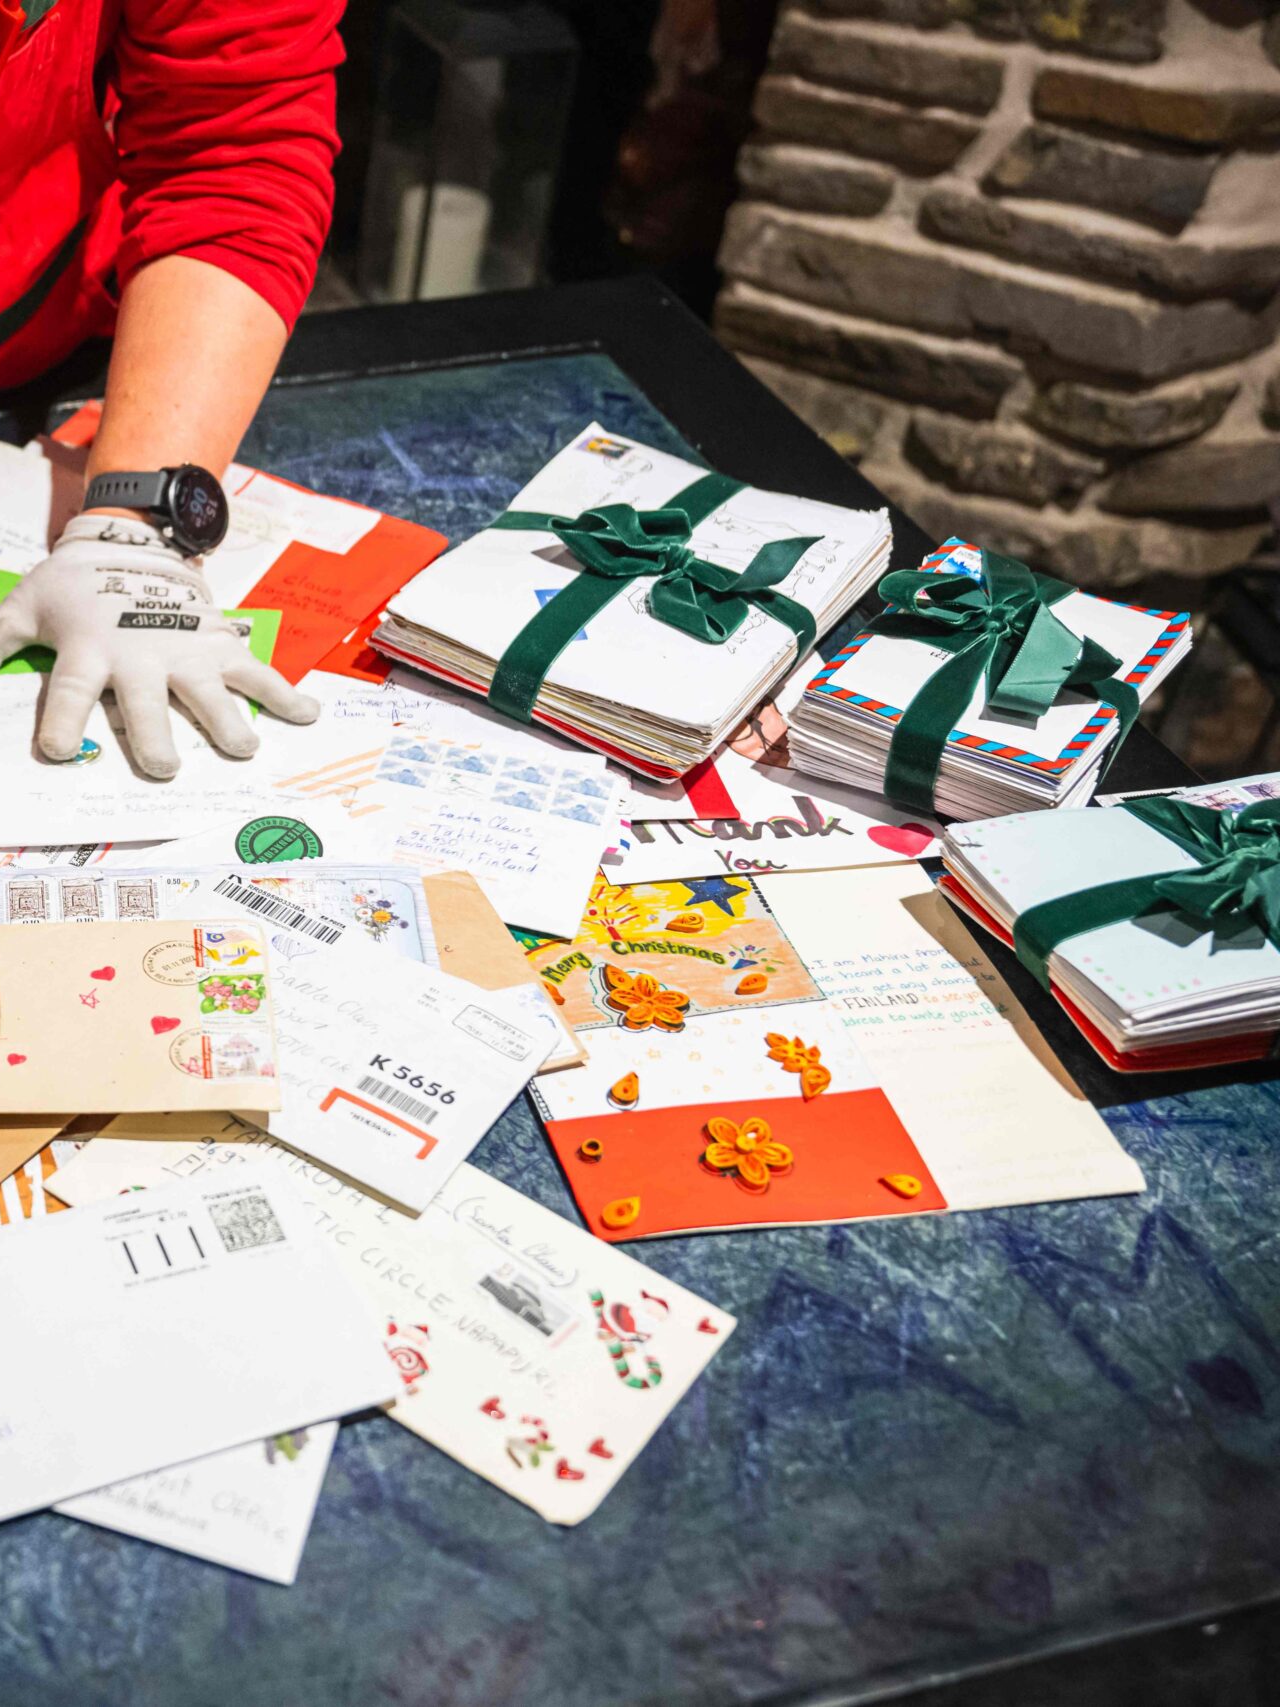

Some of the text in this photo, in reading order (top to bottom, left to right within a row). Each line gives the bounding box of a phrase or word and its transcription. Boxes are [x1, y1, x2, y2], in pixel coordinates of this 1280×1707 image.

[135, 601, 182, 611] NYLON
[132, 613, 176, 626] GRIP
[437, 804, 534, 838] Santa Claus
[714, 849, 788, 873] You
[611, 941, 726, 965] Christmas
[540, 951, 593, 983] Merry
[833, 959, 856, 969] am
[838, 967, 884, 981] heard
[907, 961, 931, 974] lot
[940, 956, 982, 971] about
[873, 981, 898, 996] get
[900, 980, 926, 993] any
[842, 991, 920, 1010] FINLAND
[889, 1011, 907, 1022] to
[910, 1009, 946, 1022] write
[368, 1053, 392, 1072] K
[392, 1065, 457, 1105] 5656
